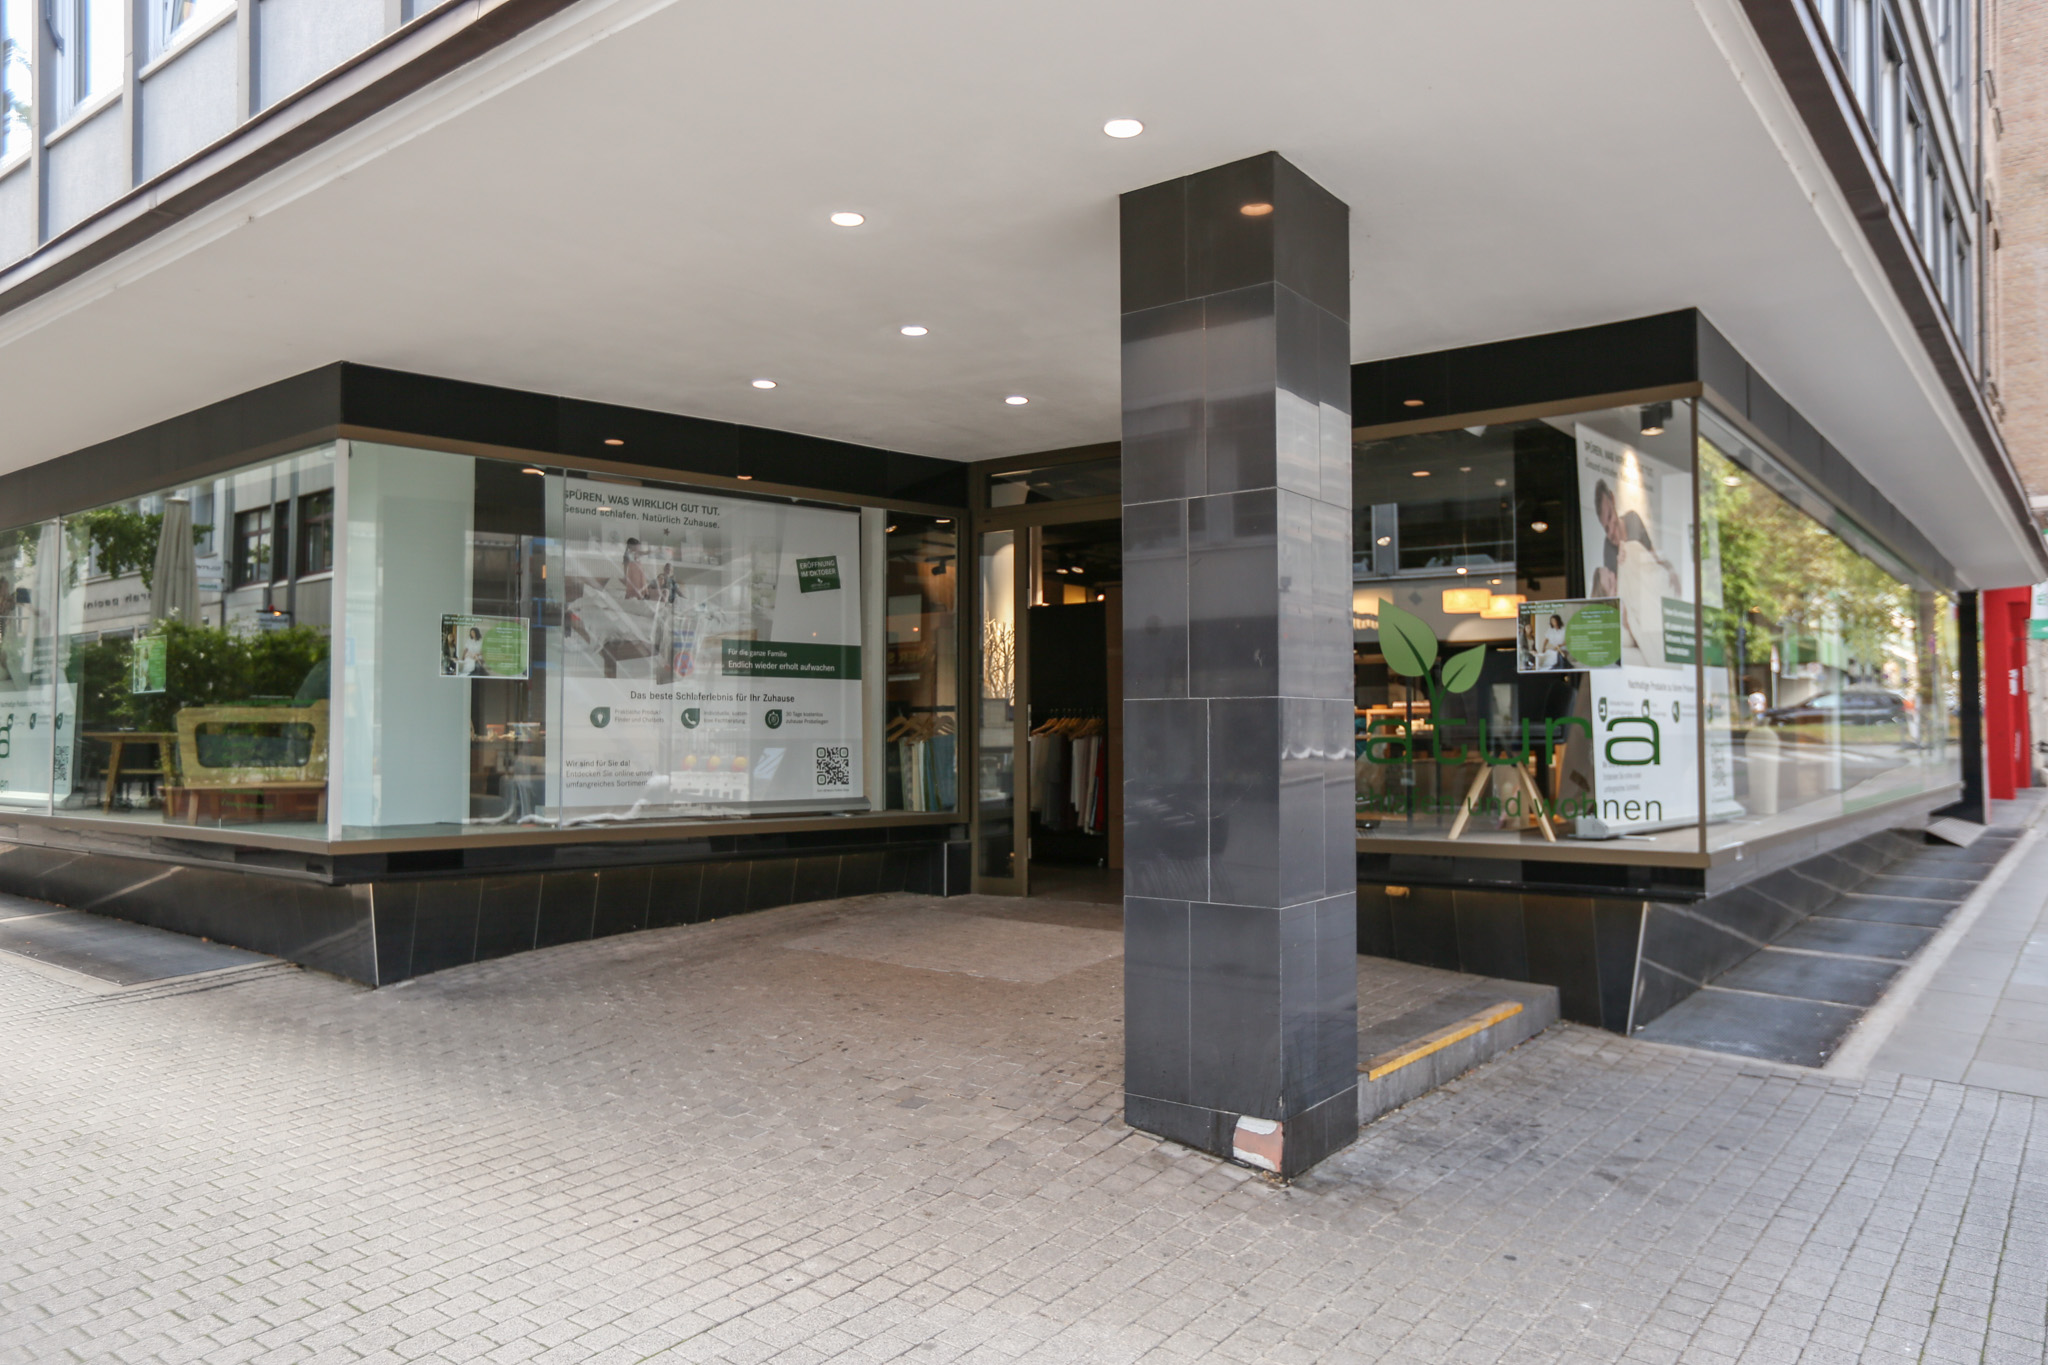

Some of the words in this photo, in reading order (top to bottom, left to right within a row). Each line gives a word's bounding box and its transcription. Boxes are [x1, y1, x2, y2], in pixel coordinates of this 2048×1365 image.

[564, 489, 605, 505] SPÜREN,
[608, 495, 629, 506] WAS
[632, 498, 678, 511] WIRKLICH
[681, 503, 698, 514] GUT
[702, 506, 720, 516] TUT.
[564, 504, 597, 516] Gesund
[600, 507, 639, 520] schlafen.
[643, 512, 681, 525] Natürlich
[683, 517, 720, 529] Zuhause.
[800, 559, 835, 569] ERÖFFNUNG
[809, 568, 837, 577] OKTOBER
[728, 660, 753, 669] Endlich
[755, 661, 777, 670] wieder
[779, 662, 799, 670] erholt
[800, 663, 835, 671] aufwachen
[630, 691, 647, 700] Das
[649, 691, 673, 700] beste
[676, 691, 733, 701] Schlaferlebnis
[736, 693, 747, 701] für
[750, 694, 760, 702] Ihr
[763, 694, 795, 702] Zuhause
[566, 770, 601, 778] Entdecken
[566, 780, 615, 789] umfangreiches
[1355, 787, 1455, 816] chlafen
[1467, 790, 1522, 819] und
[1533, 791, 1663, 822] wohnen
